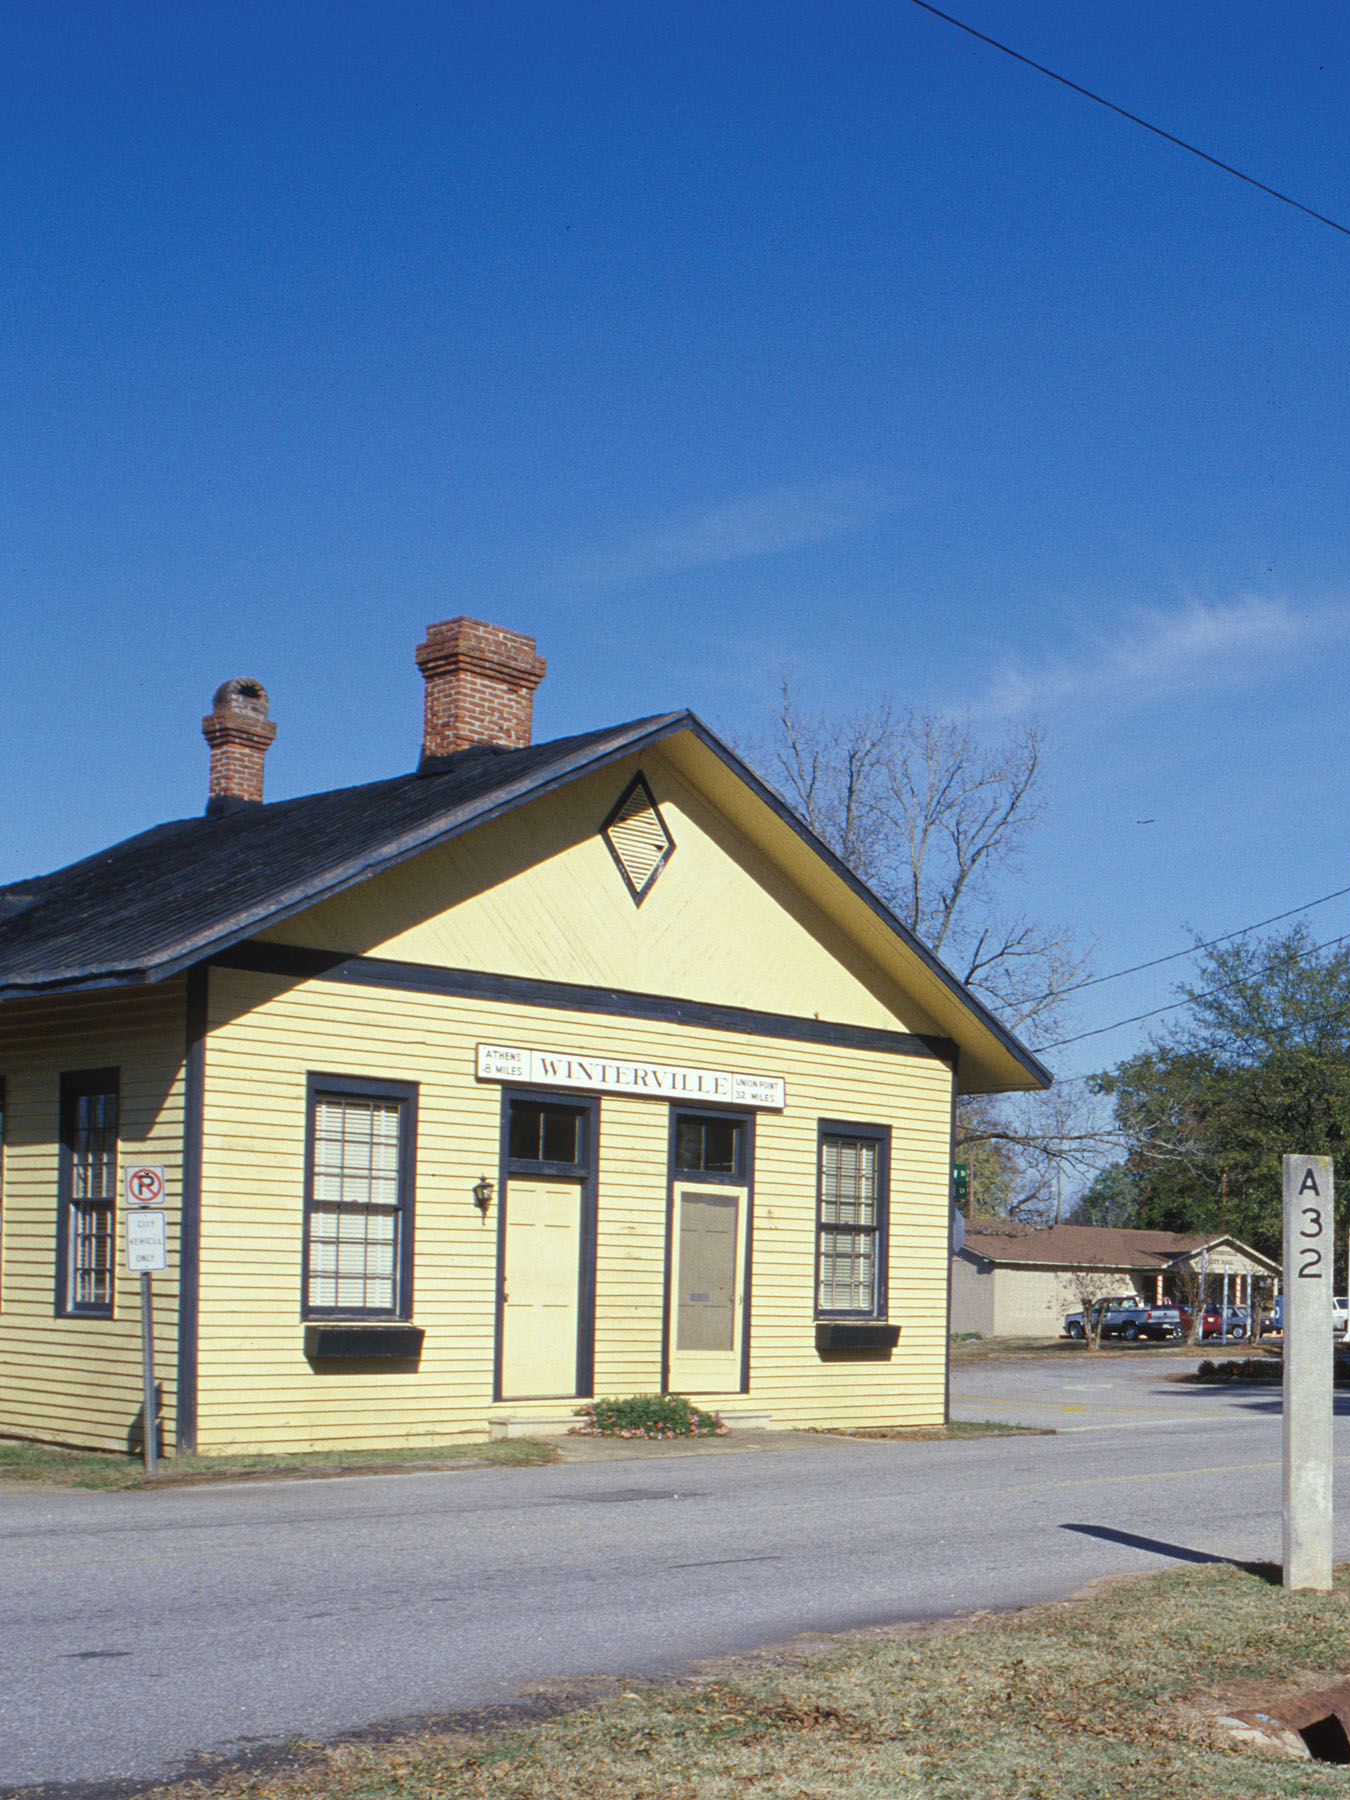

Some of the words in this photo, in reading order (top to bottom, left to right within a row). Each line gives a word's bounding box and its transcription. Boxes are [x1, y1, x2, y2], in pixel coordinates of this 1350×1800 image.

[485, 1050, 521, 1061] ATHENS
[495, 1065, 522, 1076] MILES
[541, 1058, 728, 1095] WINTERVILLE
[736, 1078, 758, 1088] UNION
[759, 1081, 779, 1090] POINT
[735, 1090, 746, 1099] 32
[751, 1093, 775, 1102] MILES
